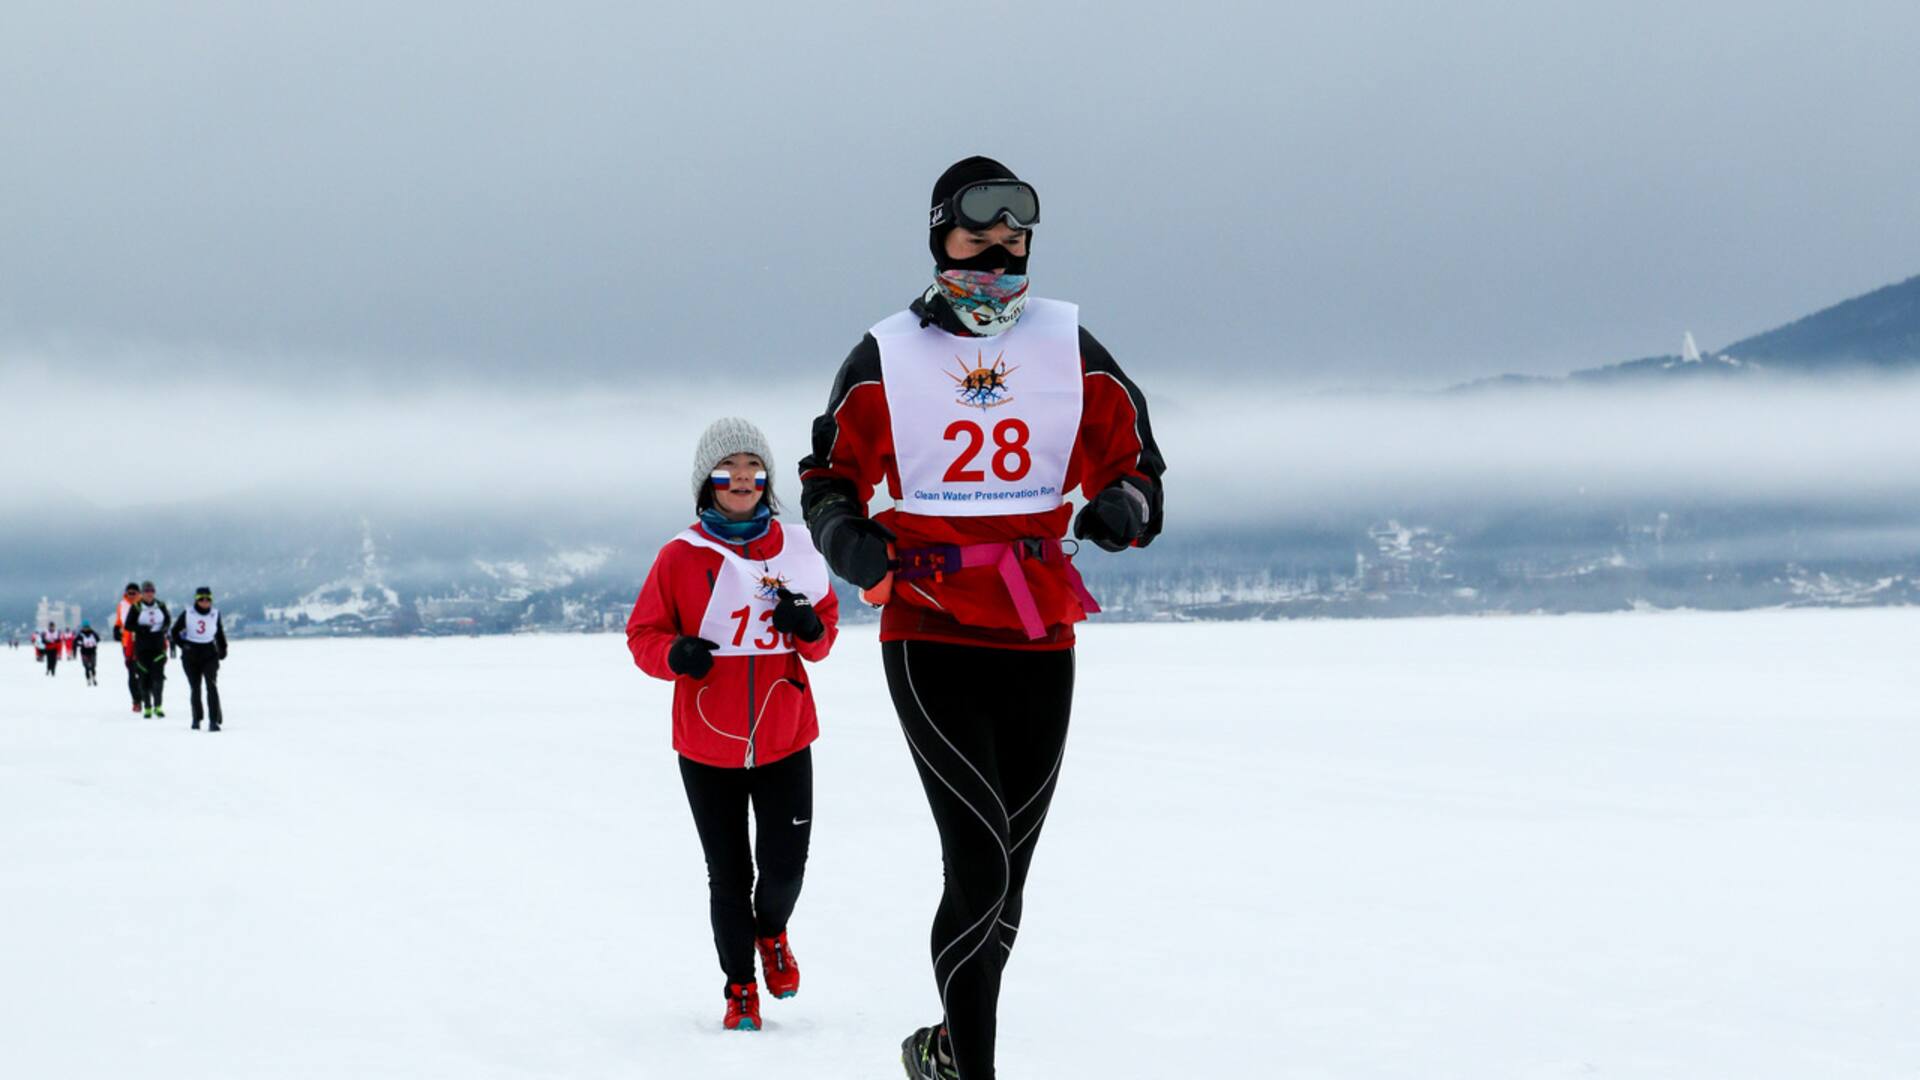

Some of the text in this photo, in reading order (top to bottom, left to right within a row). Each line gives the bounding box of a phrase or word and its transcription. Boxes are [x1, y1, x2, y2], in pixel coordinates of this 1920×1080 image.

[942, 418, 1032, 482] 28
[914, 486, 1056, 501] Clean Water Preservation Run
[196, 620, 206, 635] 3
[730, 605, 793, 650] 13
